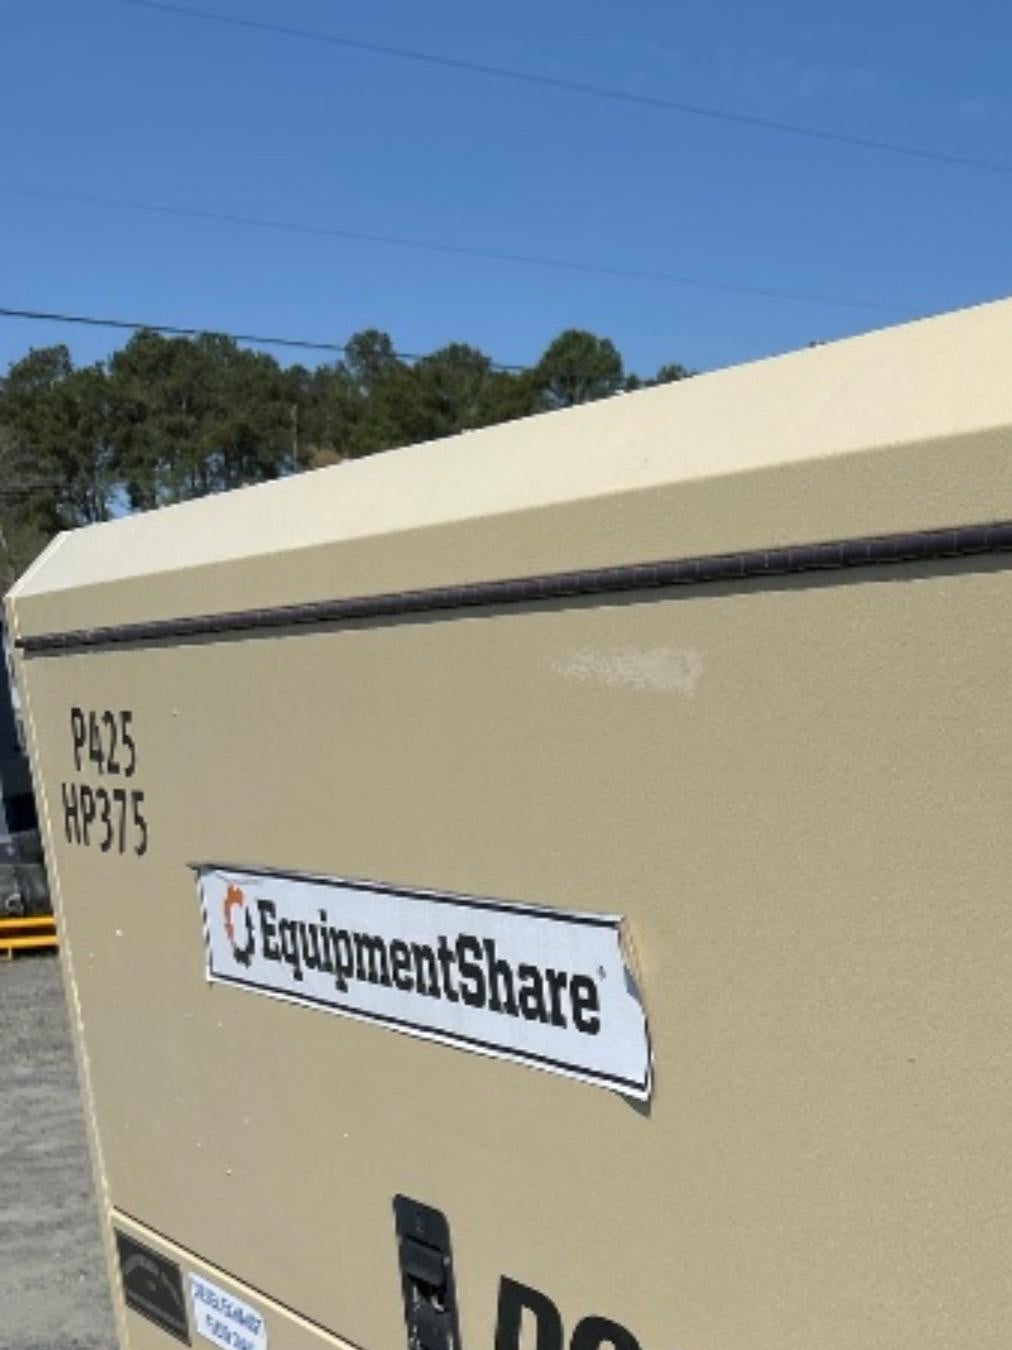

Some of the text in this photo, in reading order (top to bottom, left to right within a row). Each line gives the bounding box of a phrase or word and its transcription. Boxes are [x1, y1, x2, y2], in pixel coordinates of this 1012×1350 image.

[71, 706, 136, 777] P425
[61, 782, 148, 857] HP375
[257, 900, 601, 1035] EquipmentShare
